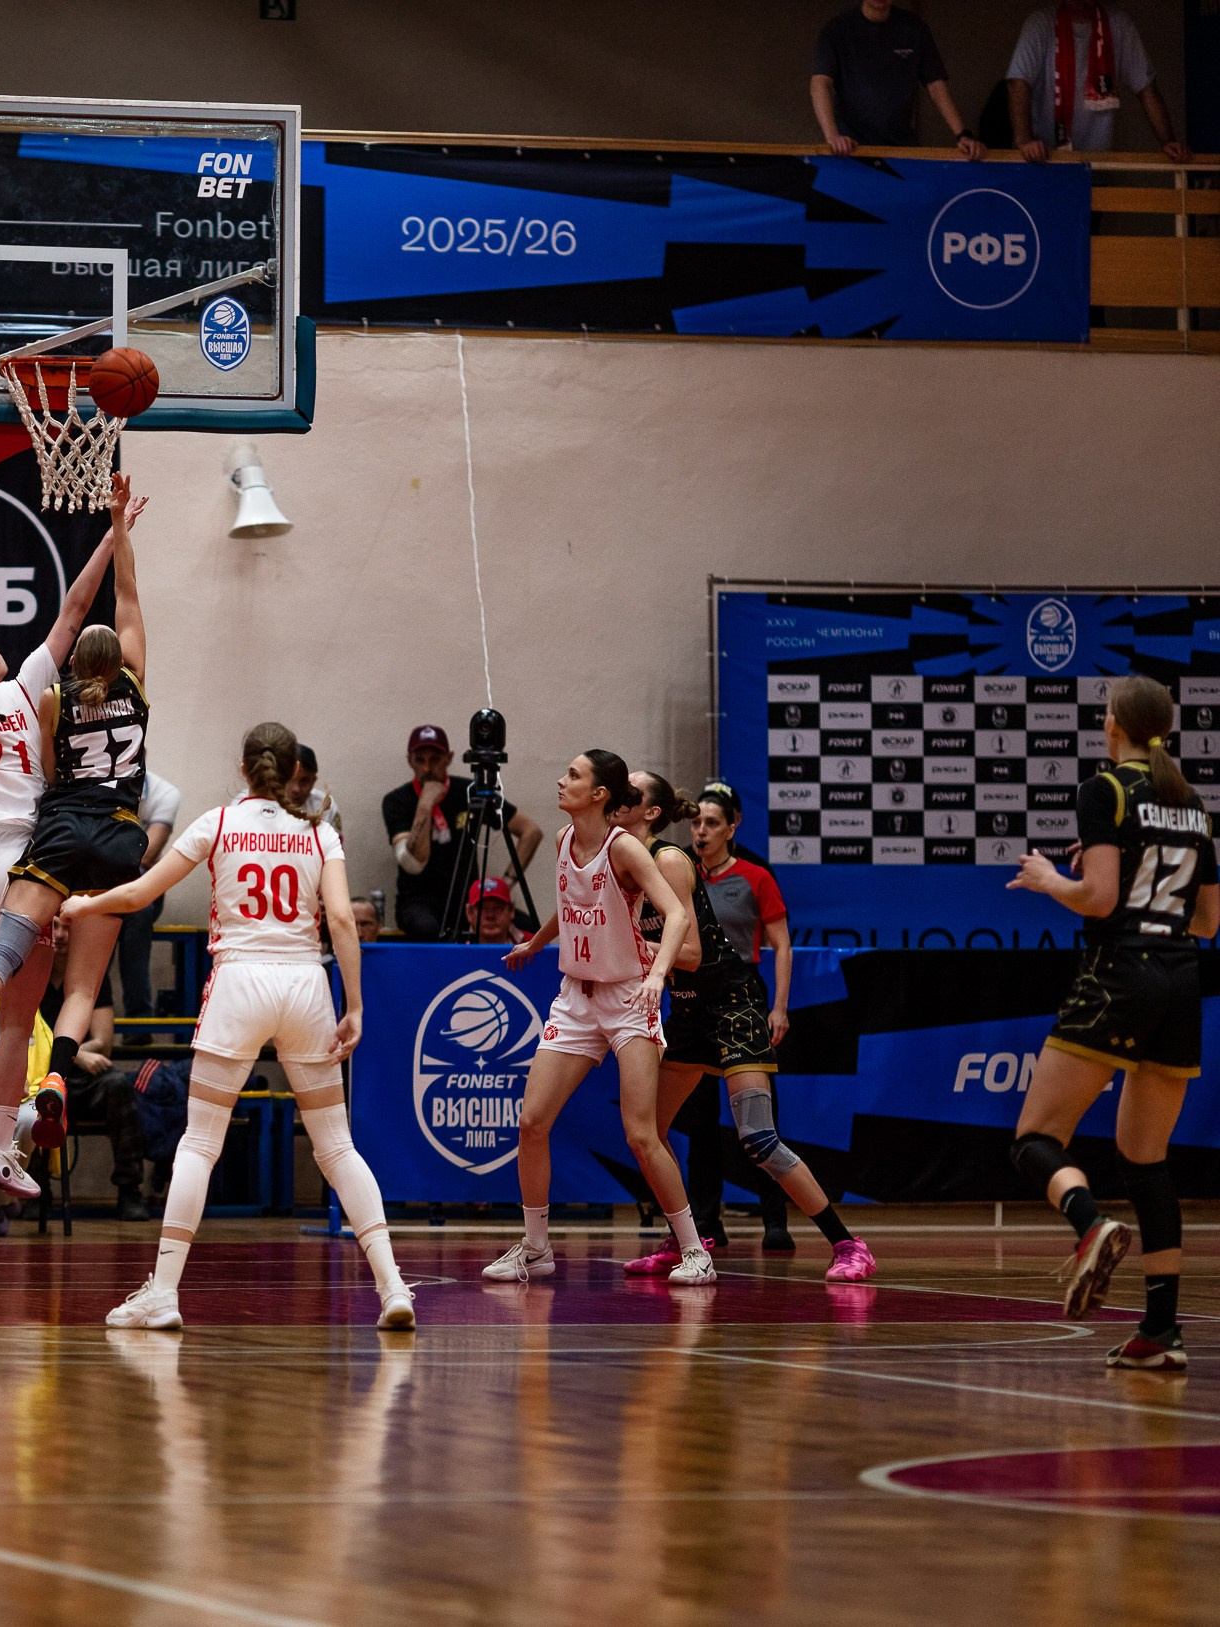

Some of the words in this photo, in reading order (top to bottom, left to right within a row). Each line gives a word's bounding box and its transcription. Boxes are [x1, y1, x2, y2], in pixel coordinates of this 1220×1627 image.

[197, 152, 253, 175] FON
[197, 176, 253, 199] BET
[156, 211, 270, 240] Fonbet
[401, 216, 577, 257] 2025/26
[943, 231, 1027, 266] РФБ
[208, 341, 243, 353] ВЫСШАЯ
[68, 724, 145, 780] 32
[222, 832, 313, 856] КРИВОШЕИНА
[237, 863, 299, 923] 30
[1125, 844, 1198, 917] 12
[573, 935, 591, 963] 14
[446, 1074, 518, 1089] FONBET
[464, 1130, 496, 1148] ЛИГА
